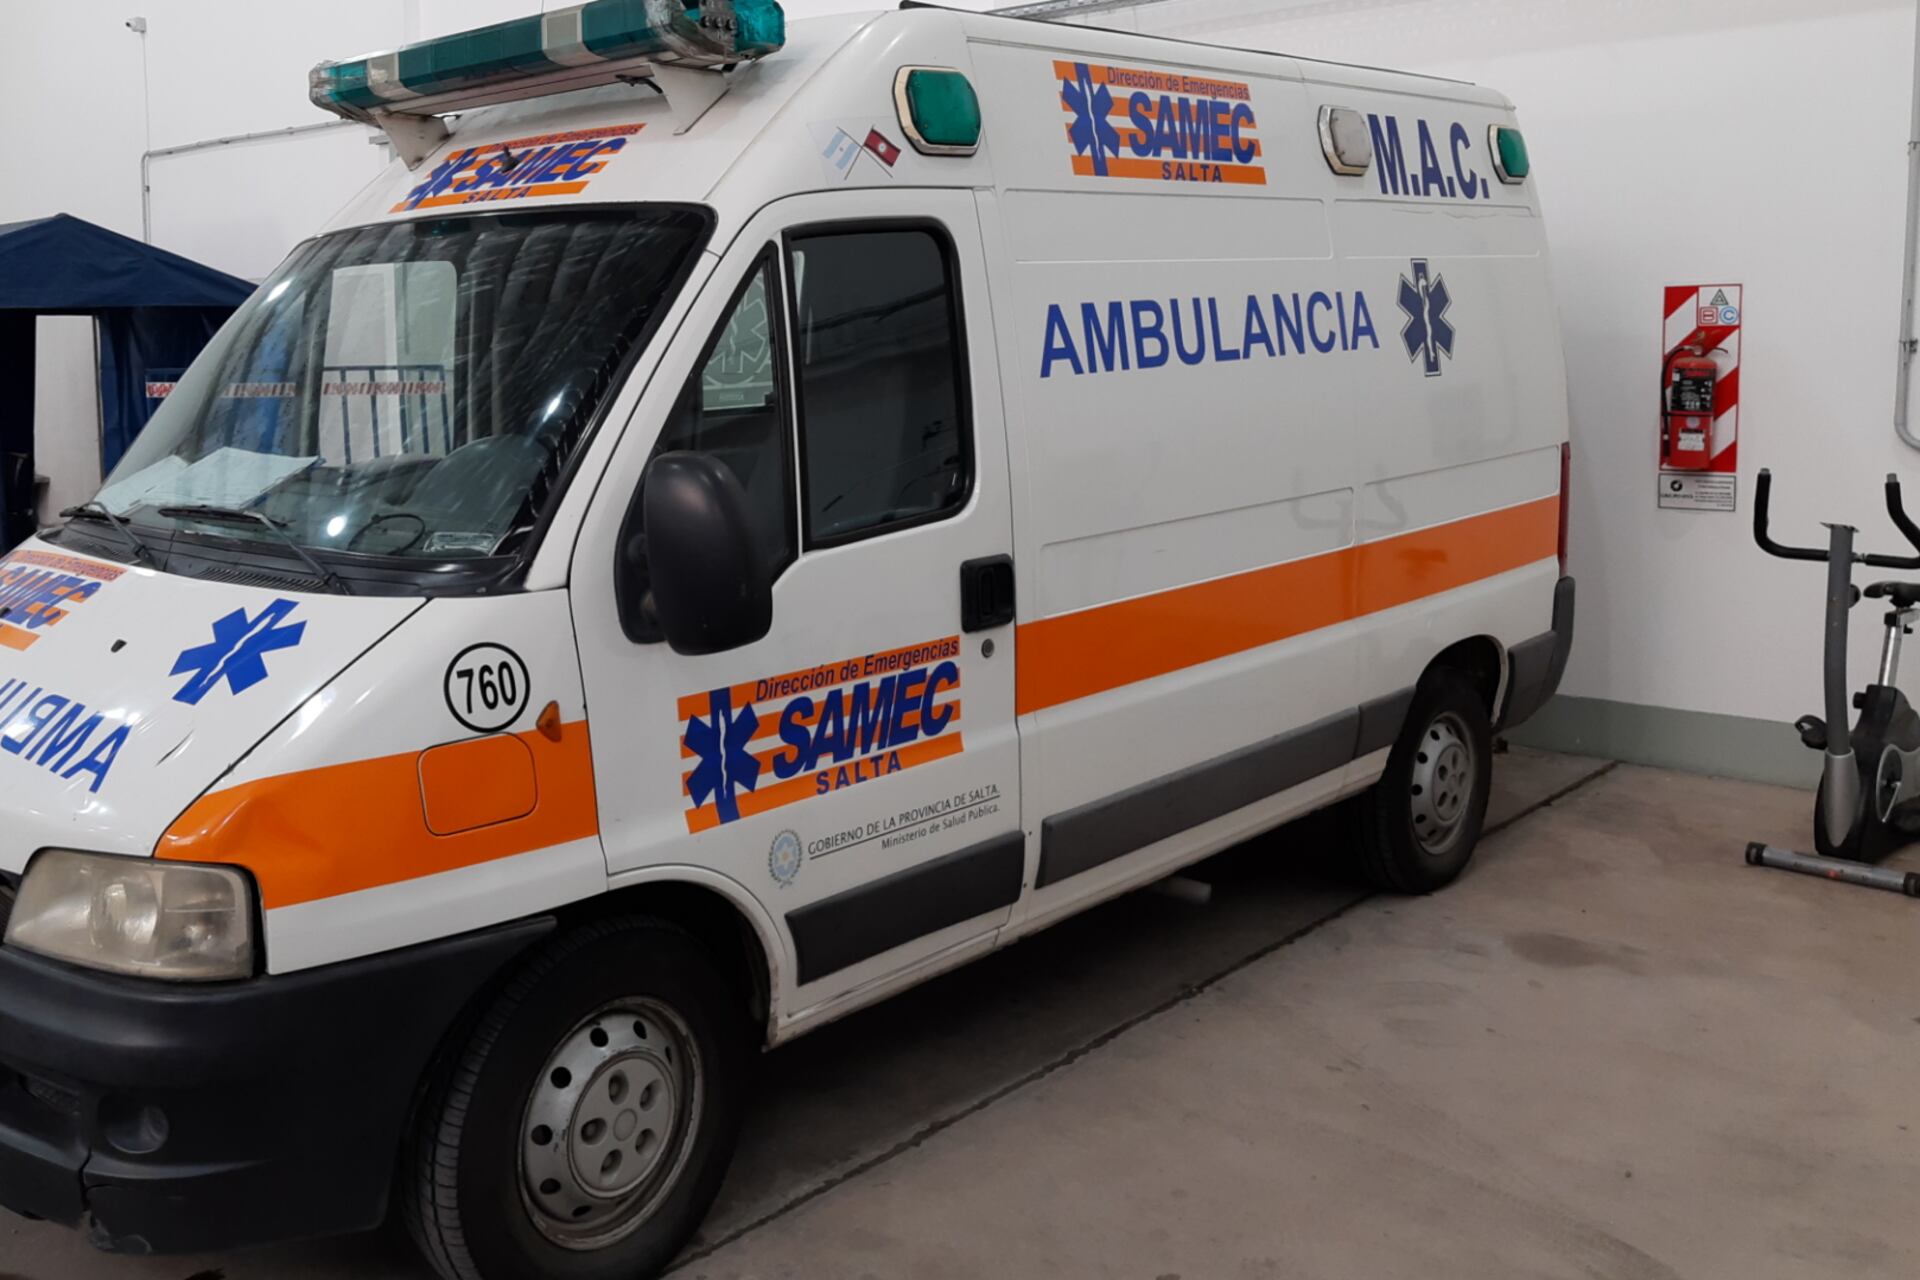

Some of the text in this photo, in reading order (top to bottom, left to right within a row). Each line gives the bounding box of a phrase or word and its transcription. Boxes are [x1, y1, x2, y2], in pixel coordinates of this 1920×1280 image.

[1107, 66, 1250, 100] Dirección de Emergencias
[1128, 91, 1256, 165] SAMEC
[1367, 113, 1490, 200] M.A.C.
[453, 137, 628, 193] SAMEC
[1161, 161, 1223, 183] SALTA
[1039, 290, 1380, 379] AMBULANCIA
[456, 660, 518, 715] 760
[755, 638, 959, 702] Dirección de Emergencias
[773, 660, 959, 780] SAMEC
[816, 750, 903, 795] SALTA
[807, 826, 864, 855] GOBIERNO
[866, 821, 881, 836] DE
[883, 816, 896, 831] LA
[898, 799, 951, 826] PROVINCIA
[953, 793, 967, 808] DE
[881, 827, 927, 850] Ministerio
[929, 821, 941, 834] de
[943, 813, 967, 831] Salud
